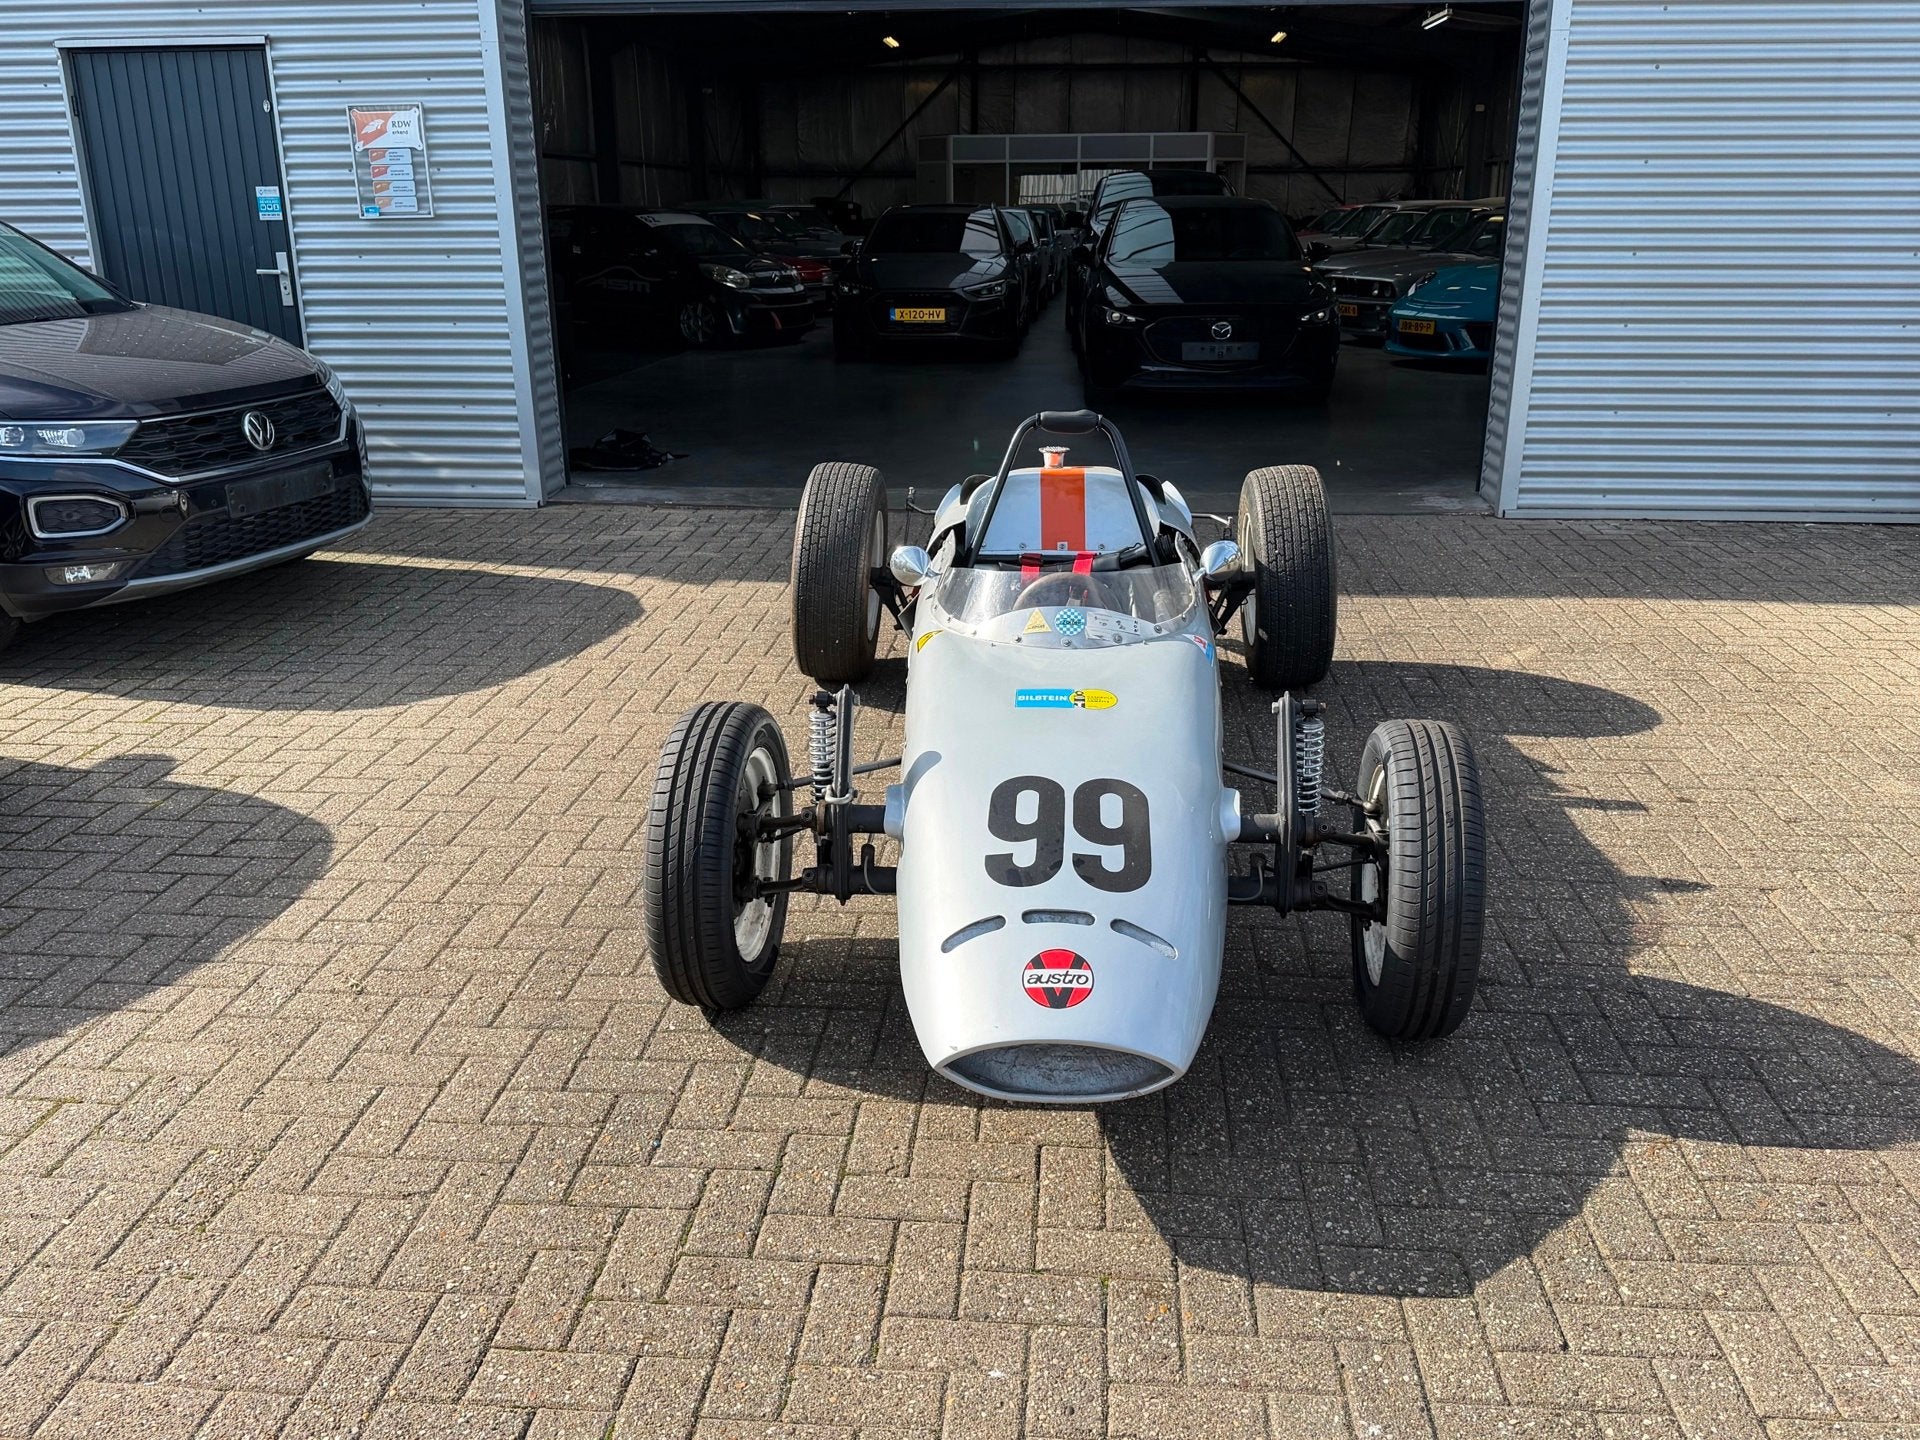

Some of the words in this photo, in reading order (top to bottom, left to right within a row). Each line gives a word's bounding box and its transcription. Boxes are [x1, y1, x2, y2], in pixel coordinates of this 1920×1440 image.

[391, 120, 411, 128] RDW
[985, 775, 1152, 892] 99
[1026, 970, 1089, 985] austro
